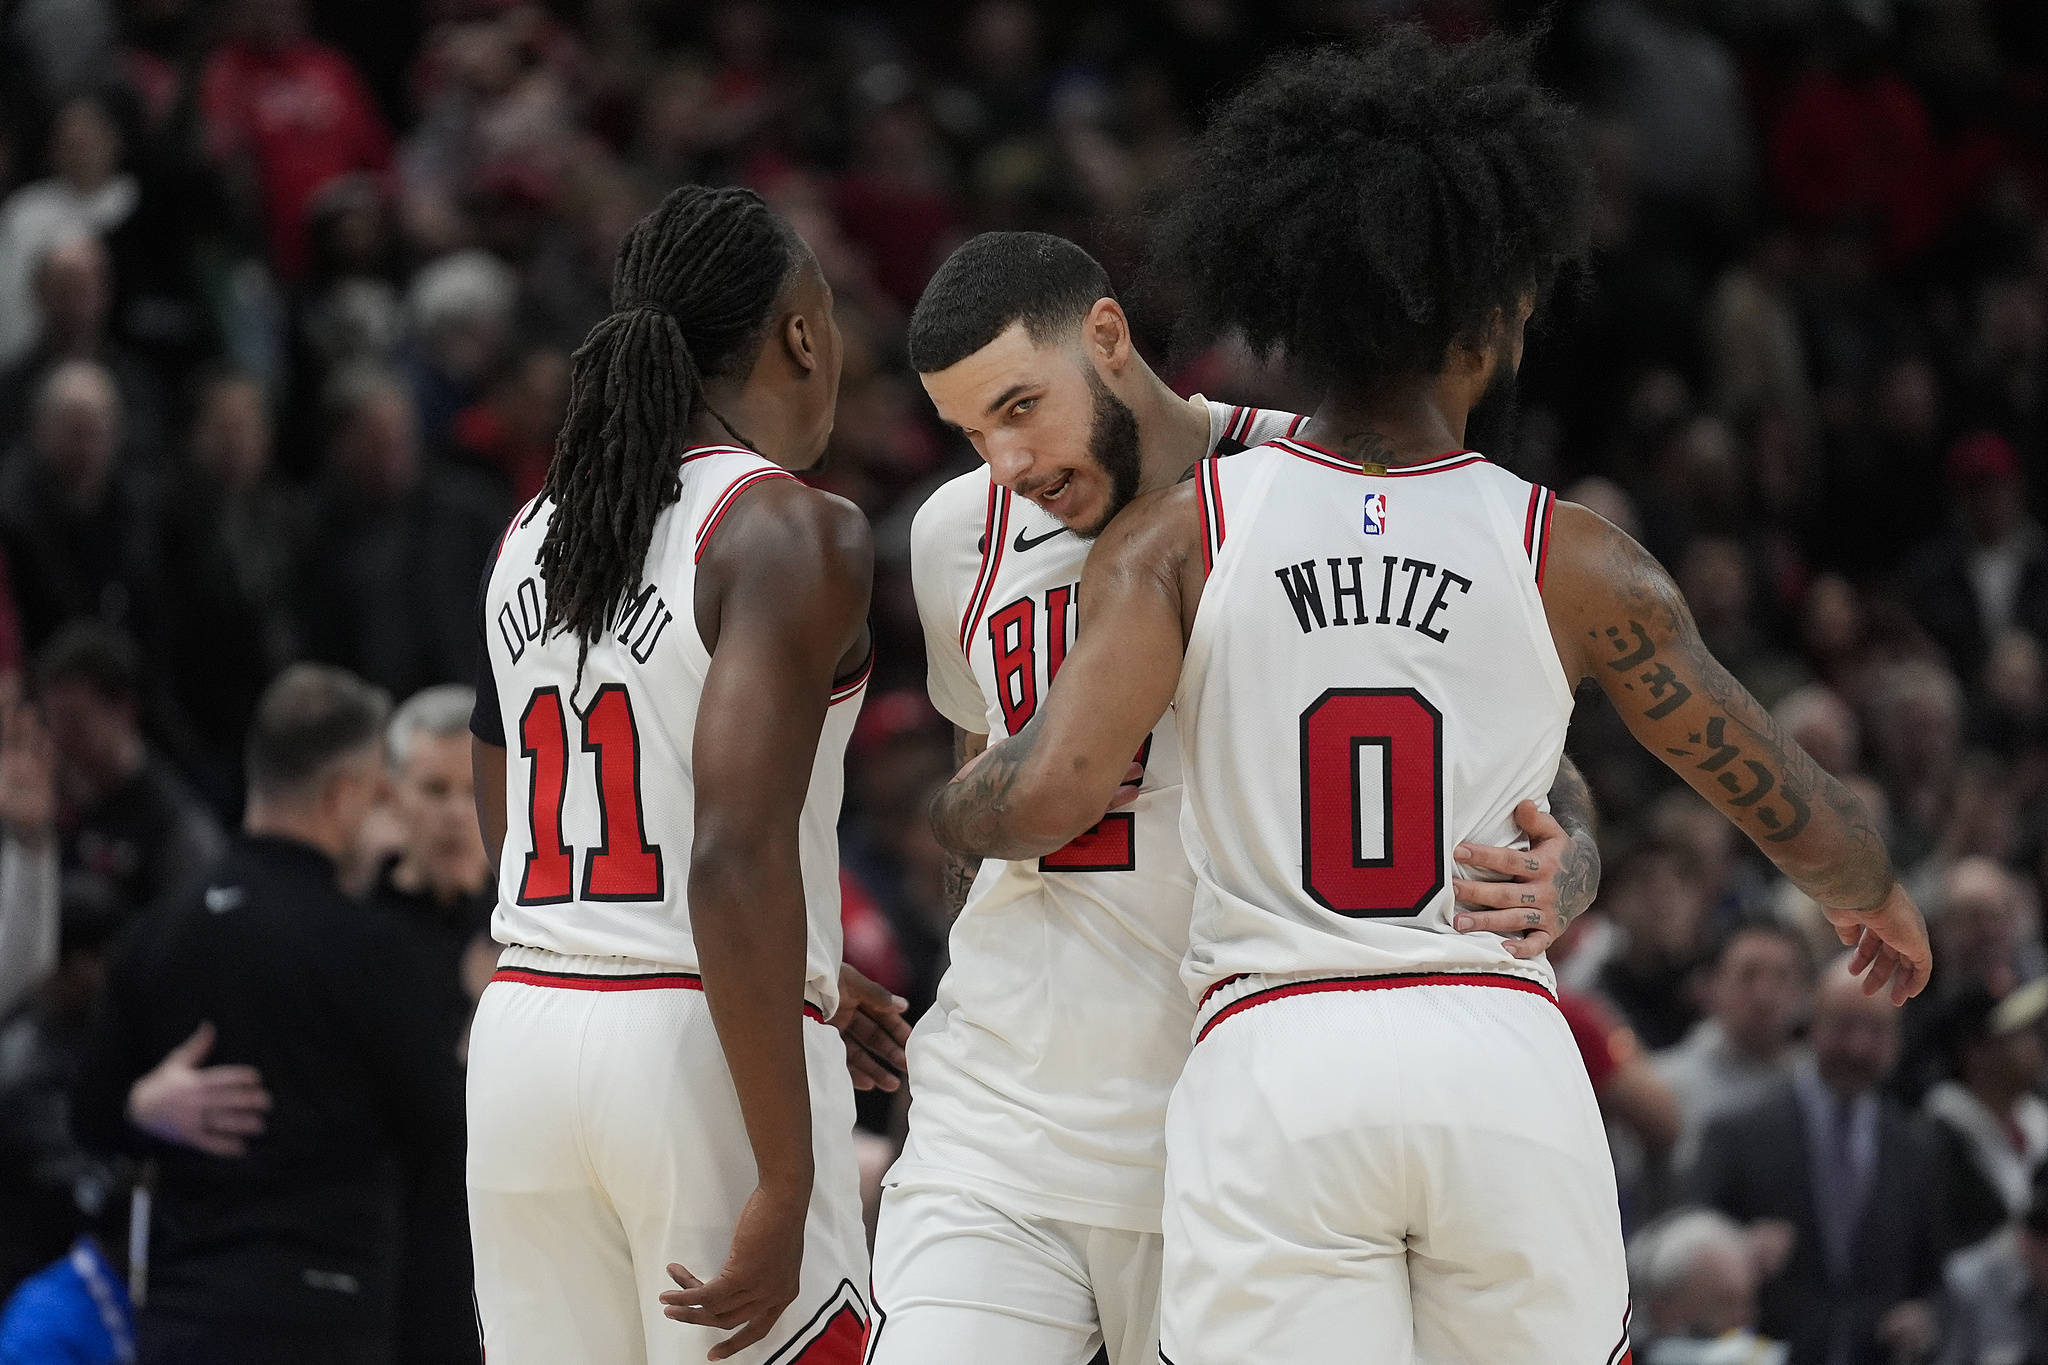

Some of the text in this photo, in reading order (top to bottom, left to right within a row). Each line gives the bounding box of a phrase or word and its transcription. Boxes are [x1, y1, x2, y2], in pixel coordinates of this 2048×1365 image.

[498, 577, 673, 665] DOMU
[1275, 556, 1472, 643] WHITE
[516, 683, 664, 906] 11
[1300, 688, 1445, 917] 0
